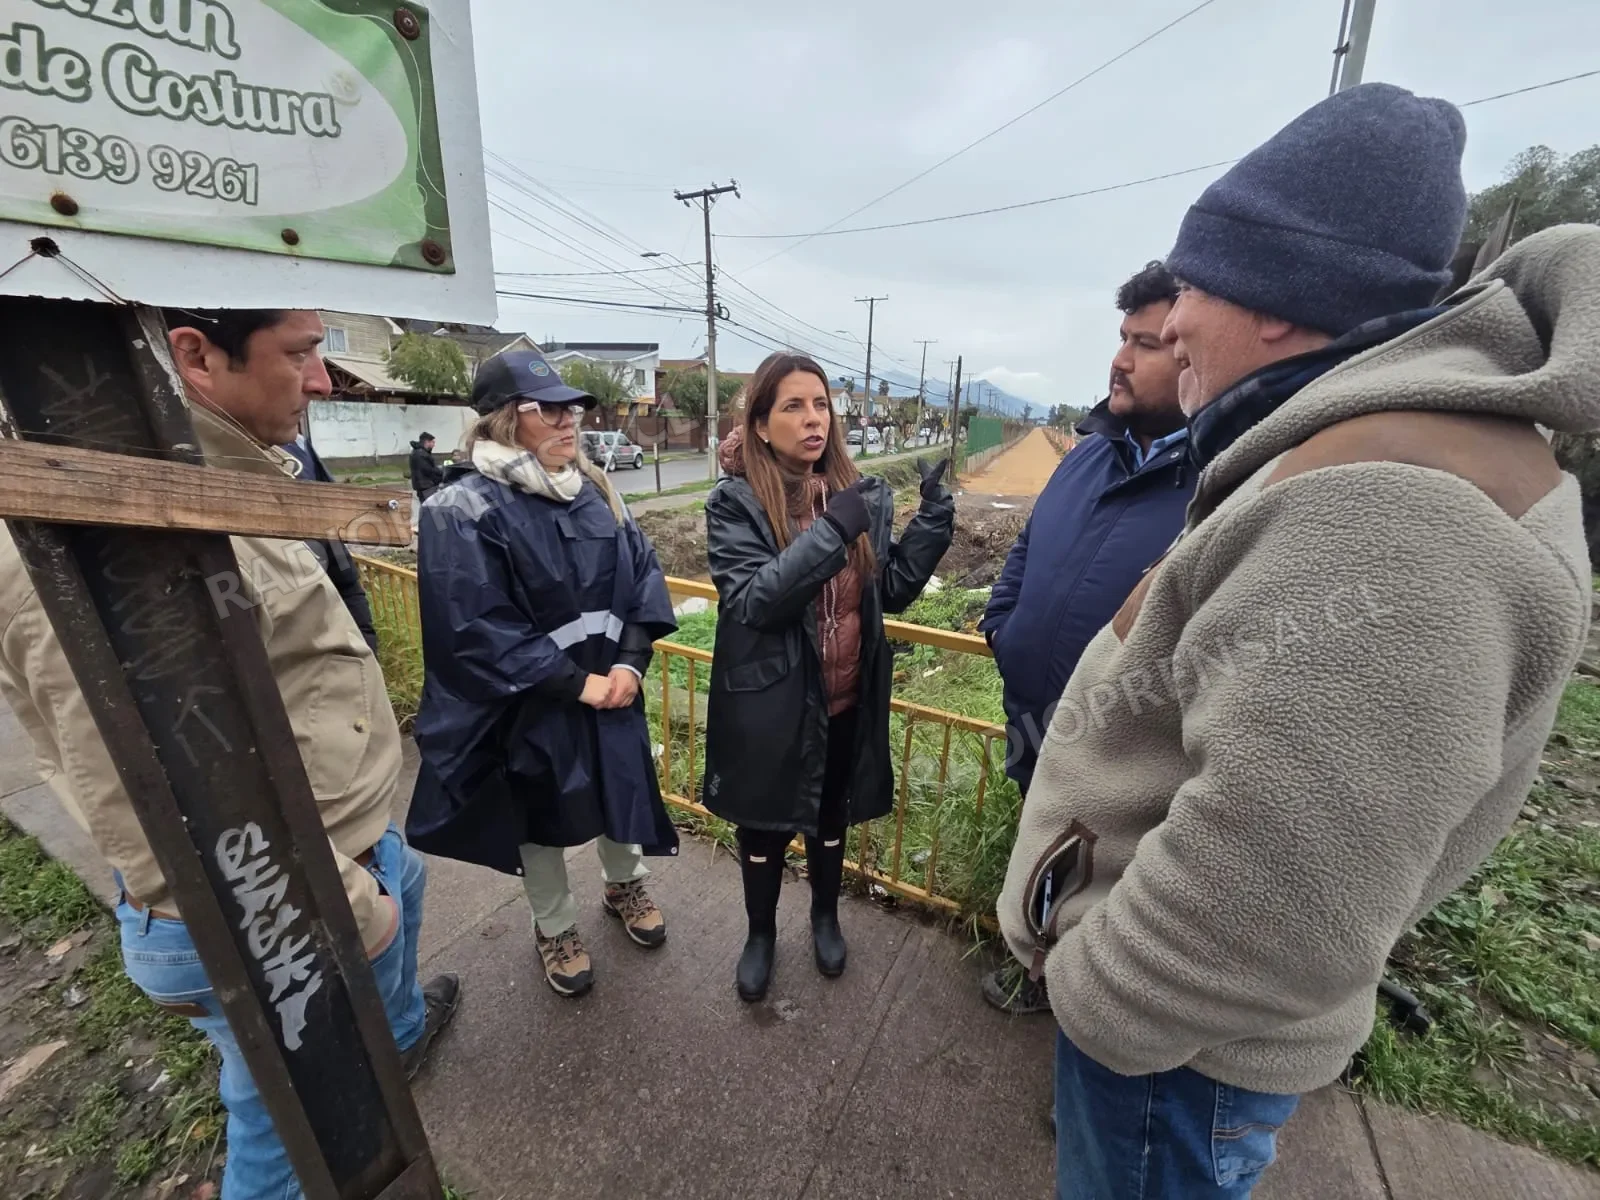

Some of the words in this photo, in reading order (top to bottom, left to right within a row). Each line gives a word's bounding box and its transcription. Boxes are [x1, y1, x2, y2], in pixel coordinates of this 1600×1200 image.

[0, 22, 92, 103] de
[102, 42, 341, 138] Costura
[0, 116, 139, 184] 6139
[148, 144, 259, 205] 9261
